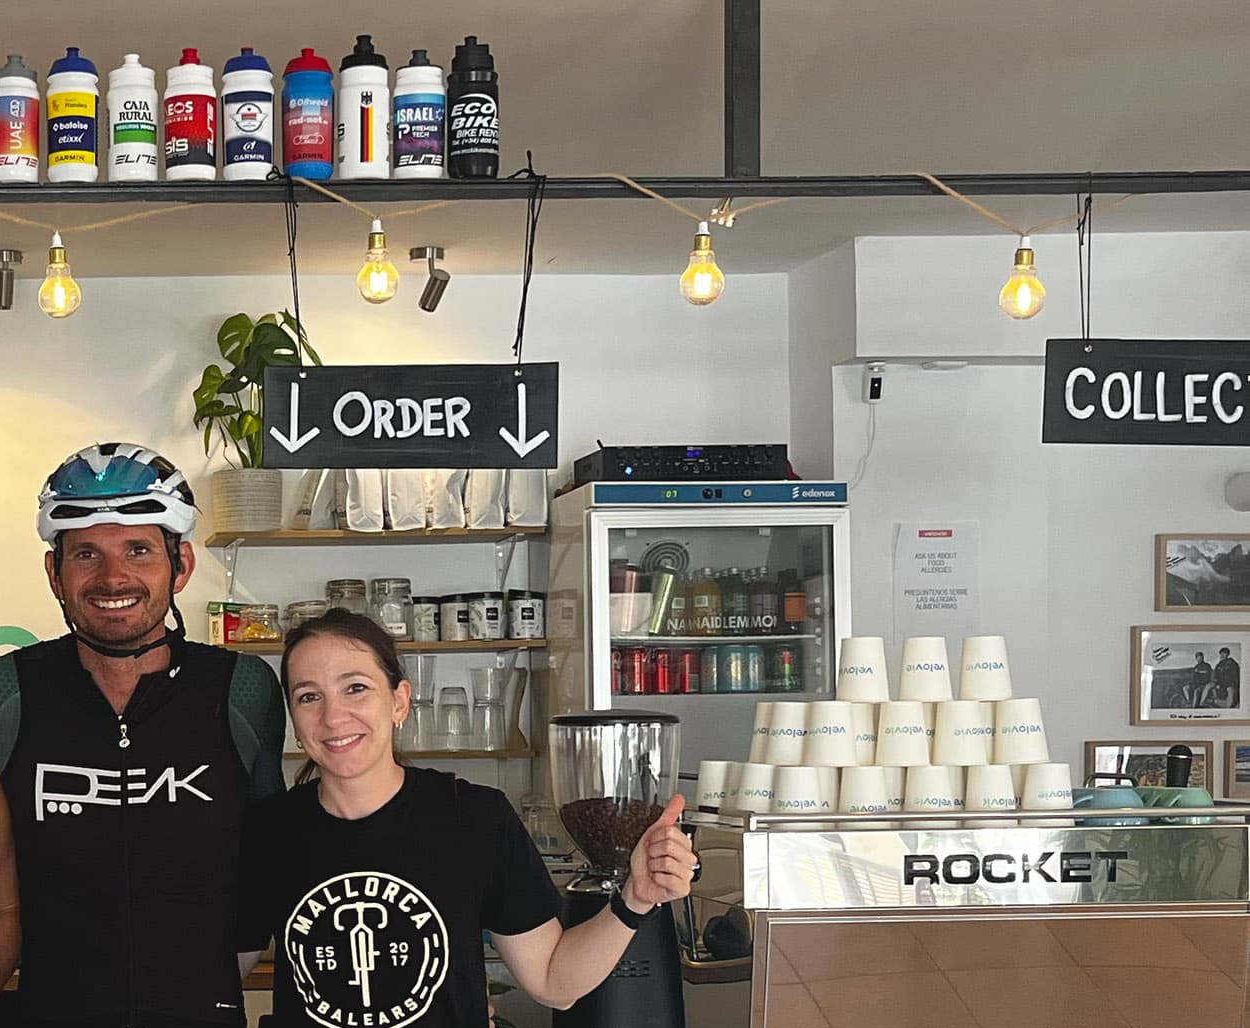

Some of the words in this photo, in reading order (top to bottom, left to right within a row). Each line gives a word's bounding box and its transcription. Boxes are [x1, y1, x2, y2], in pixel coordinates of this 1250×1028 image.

[123, 101, 150, 111] CAJA
[451, 102, 496, 117] ECO
[119, 111, 153, 122] RURAL
[397, 107, 434, 124] ISRAEL
[451, 116, 499, 130] BIKE
[10, 121, 23, 150] UAE
[456, 129, 477, 138] BIKE
[1064, 367, 1250, 424] COLLEC
[333, 390, 471, 439] ORDER
[802, 488, 836, 498] edenox
[906, 662, 946, 673] velovie
[1001, 724, 1041, 735] velovie
[903, 851, 1129, 885] ROCKET
[292, 877, 432, 936] MALLORCA
[315, 946, 335, 958] ES
[389, 942, 409, 954] 20
[315, 958, 338, 971] TD
[391, 954, 409, 967] 17
[316, 997, 419, 1026] BALEARS
